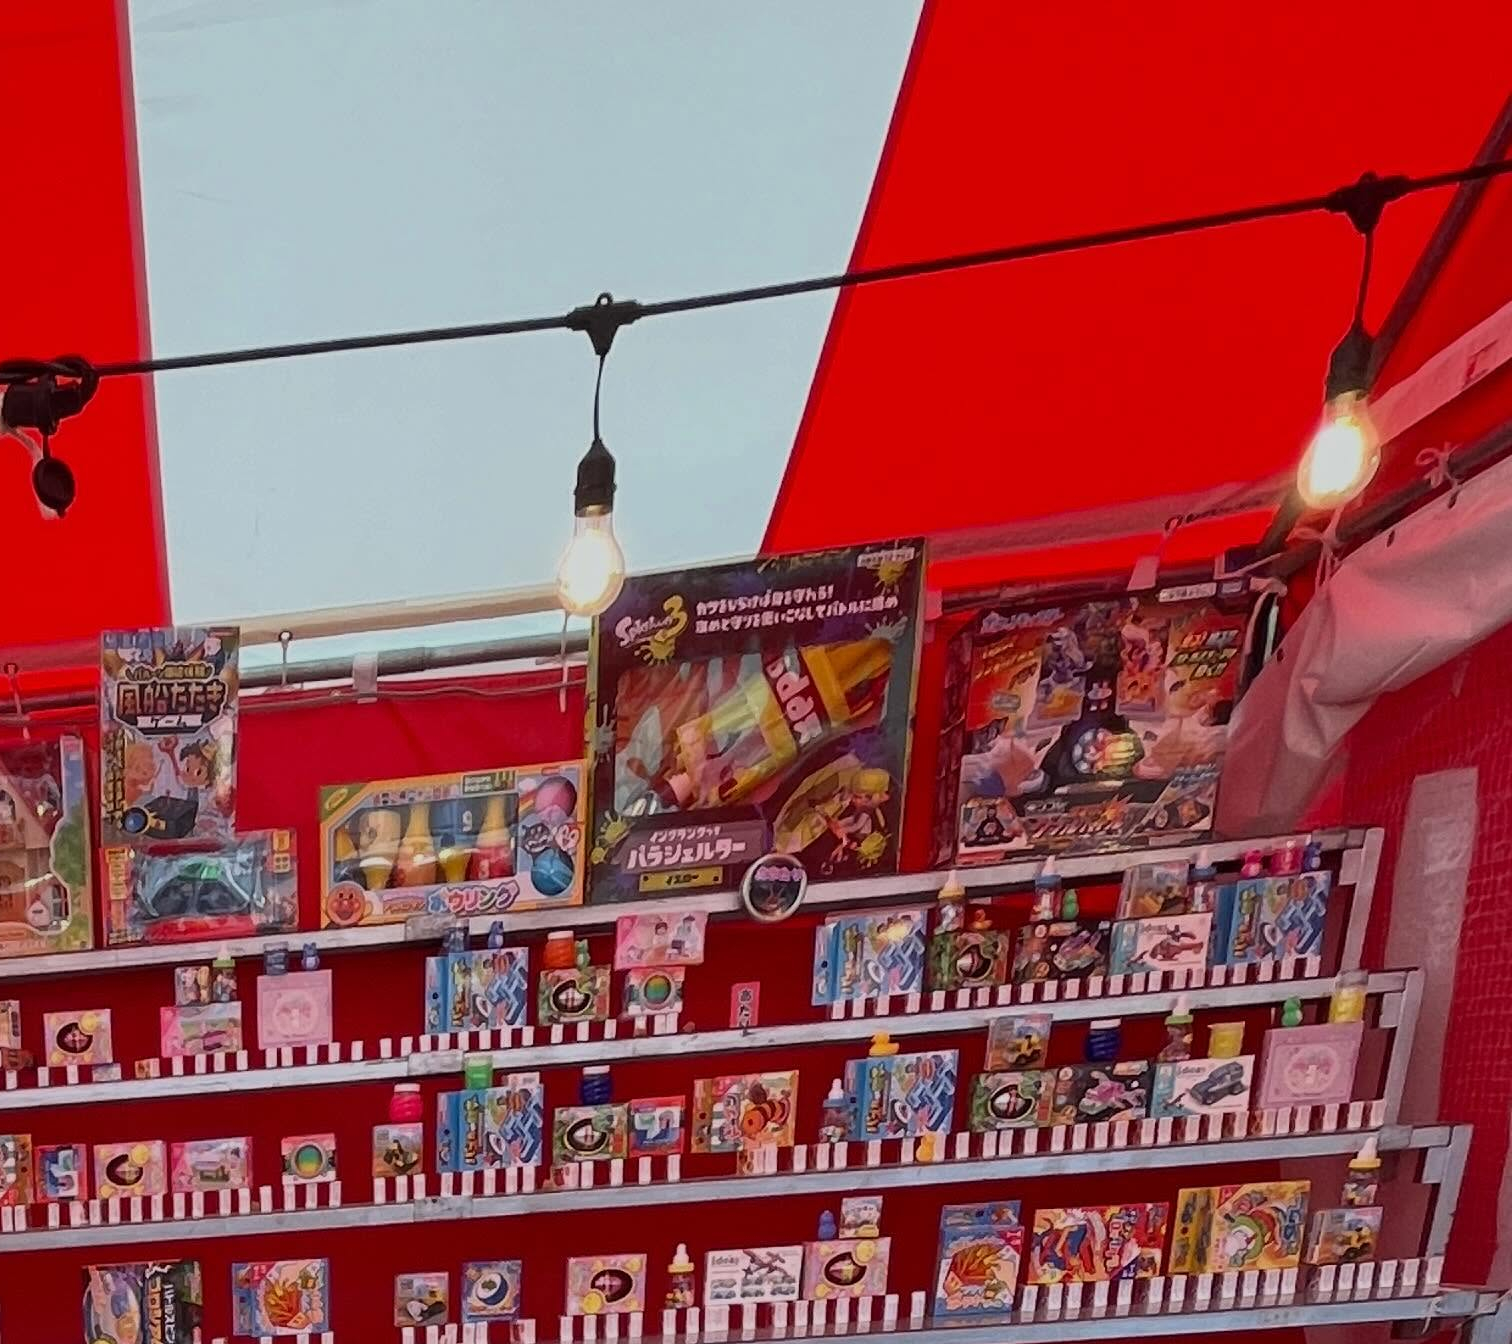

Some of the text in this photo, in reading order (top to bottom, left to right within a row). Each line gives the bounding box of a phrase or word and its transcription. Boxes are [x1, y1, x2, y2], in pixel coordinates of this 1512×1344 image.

[627, 838, 746, 869] パラシェルター
